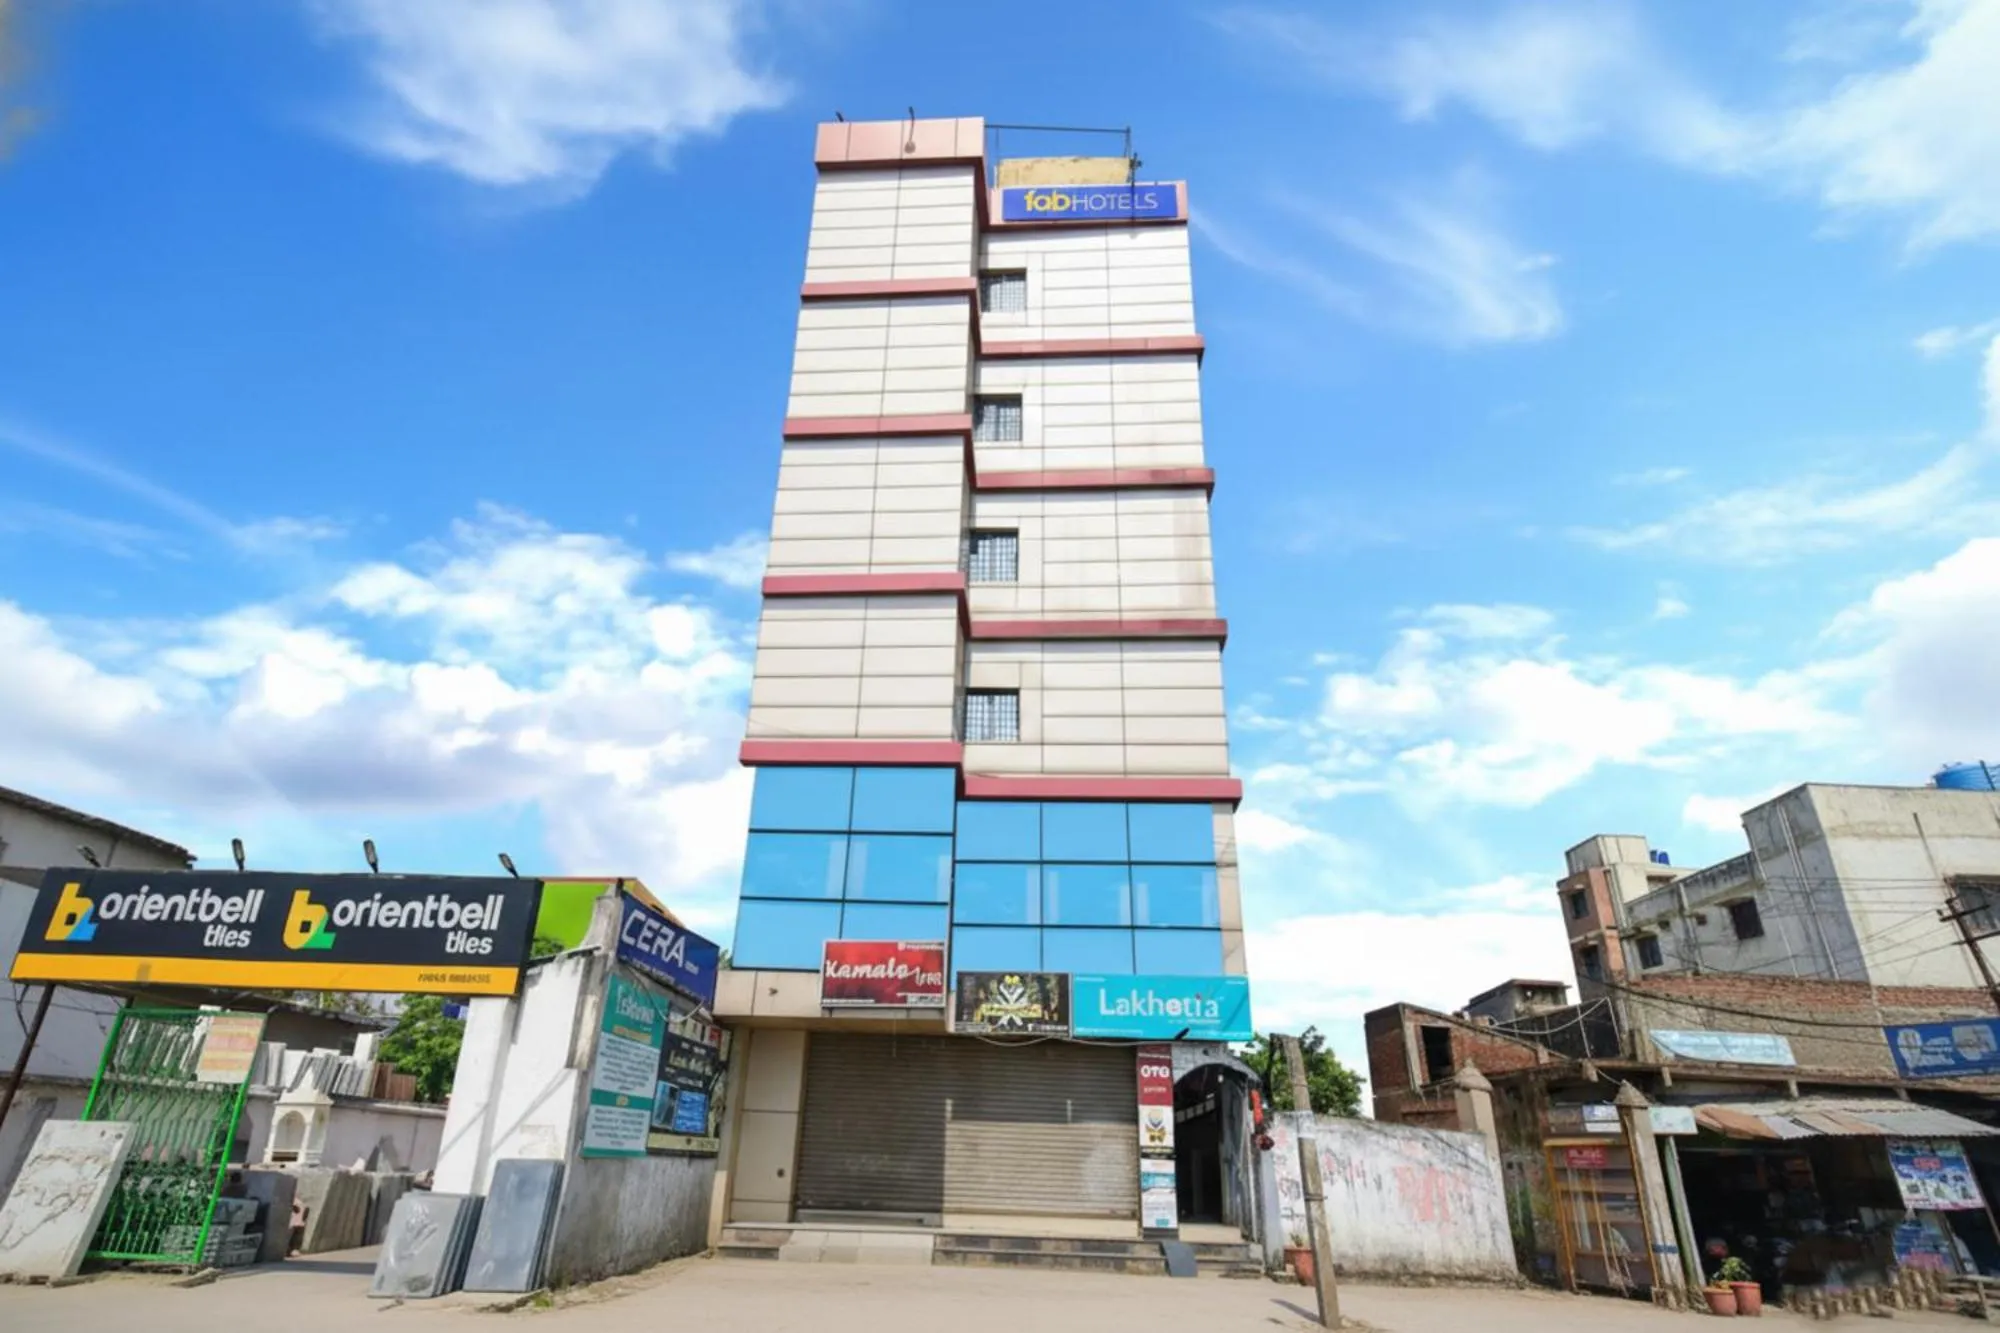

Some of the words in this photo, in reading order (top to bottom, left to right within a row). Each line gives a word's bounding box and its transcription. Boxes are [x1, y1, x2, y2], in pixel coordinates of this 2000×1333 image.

[98, 884, 265, 923] orientbell
[332, 891, 505, 931] orientbell
[203, 924, 252, 948] tiles
[445, 930, 494, 955] tiles
[621, 909, 687, 968] CERA
